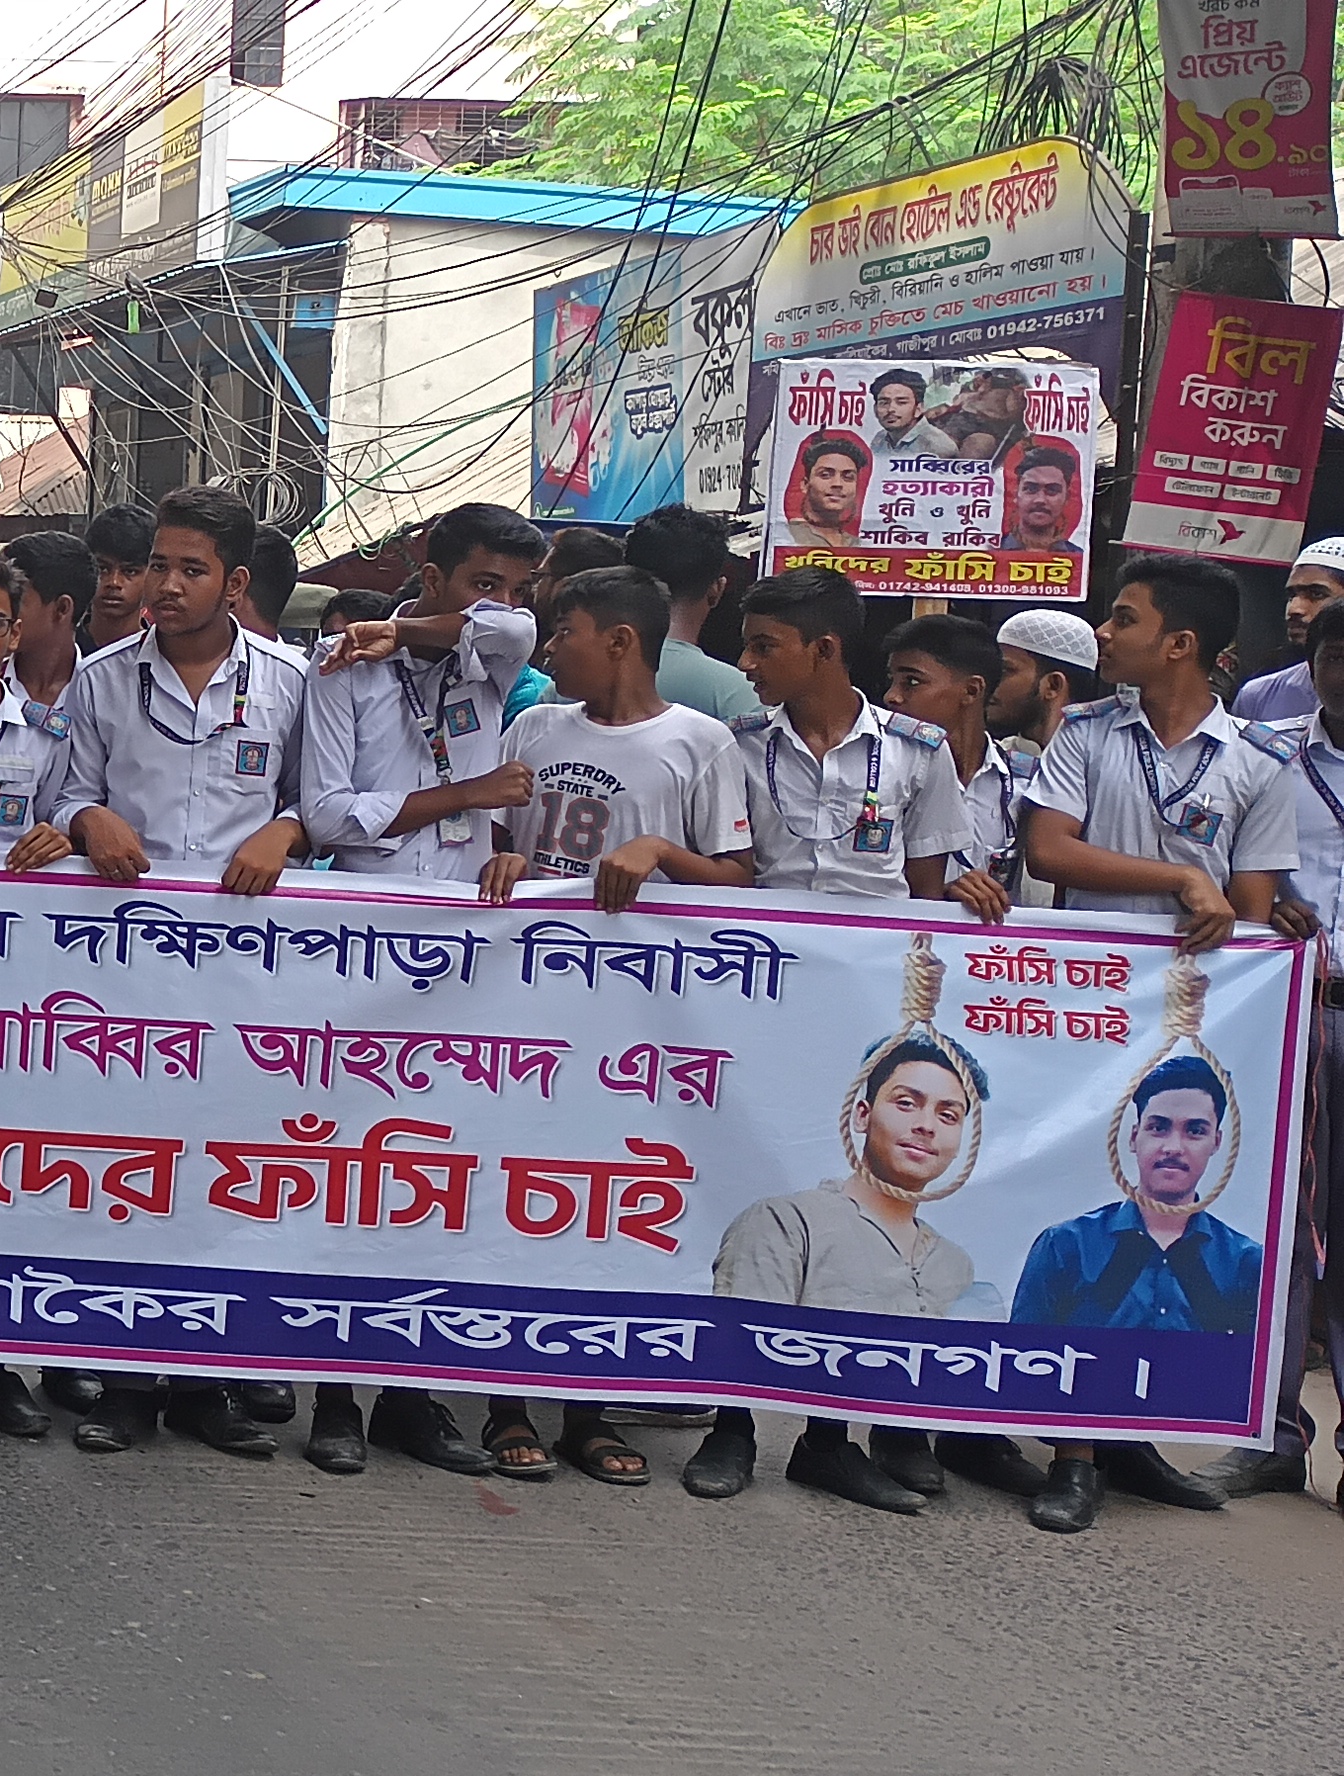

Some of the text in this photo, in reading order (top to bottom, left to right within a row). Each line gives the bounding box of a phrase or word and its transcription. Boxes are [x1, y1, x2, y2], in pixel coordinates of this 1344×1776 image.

[1201, 15, 1258, 49] প্রিয়
[1178, 40, 1287, 80] এজেন্টে
[810, 222, 835, 266] চার
[838, 204, 862, 258] ভাই
[865, 206, 898, 252] বোন
[900, 183, 952, 245] হোটেল
[775, 305, 811, 323] এখানে
[892, 273, 944, 300] বিরিয়ানি
[949, 275, 959, 288] ও
[964, 262, 1005, 285] হালিম
[1010, 254, 1054, 275] পাওয়া
[1059, 247, 1085, 265] যায়
[816, 319, 863, 341] মাসিক
[869, 308, 927, 337] চুক্তিতে
[933, 300, 965, 320] মেচ
[972, 281, 1059, 311] খাওয়ানো
[1064, 275, 1094, 294] হয়
[987, 306, 1105, 339] 01942-756371
[1206, 315, 1316, 385] বিল
[788, 368, 866, 427] ফাঁসি চাই
[1023, 373, 1090, 434] ফাঁসি চাই
[1179, 373, 1278, 416] বিকাশ
[1204, 416, 1288, 450] করুন
[881, 476, 994, 498] হত্যাকারী
[890, 454, 990, 475] সাব্বিরের
[879, 499, 991, 527] খুনি ও খুনি
[1178, 520, 1217, 540] বিকাশ
[859, 526, 1000, 548] শাকিব রাকিব
[905, 551, 1073, 585] ফাঁসি চাই
[538, 762, 627, 796] SUPERDRY
[557, 780, 595, 798] STATE
[536, 791, 611, 861] 18
[42, 902, 491, 993] দক্ষিণপাড়া
[510, 916, 798, 1002] নিবাসী
[964, 944, 1132, 993] ফাঁসি চাই
[963, 995, 1129, 1047] ফাঁসি চাই
[237, 1016, 573, 1104] আহম্মেদ
[597, 1040, 735, 1110] এর
[206, 1112, 481, 1235] ফাঁসি
[500, 1136, 695, 1256] চাই
[282, 1286, 717, 1364] সর্বস্তরের
[740, 1319, 1098, 1400] জনগণ
